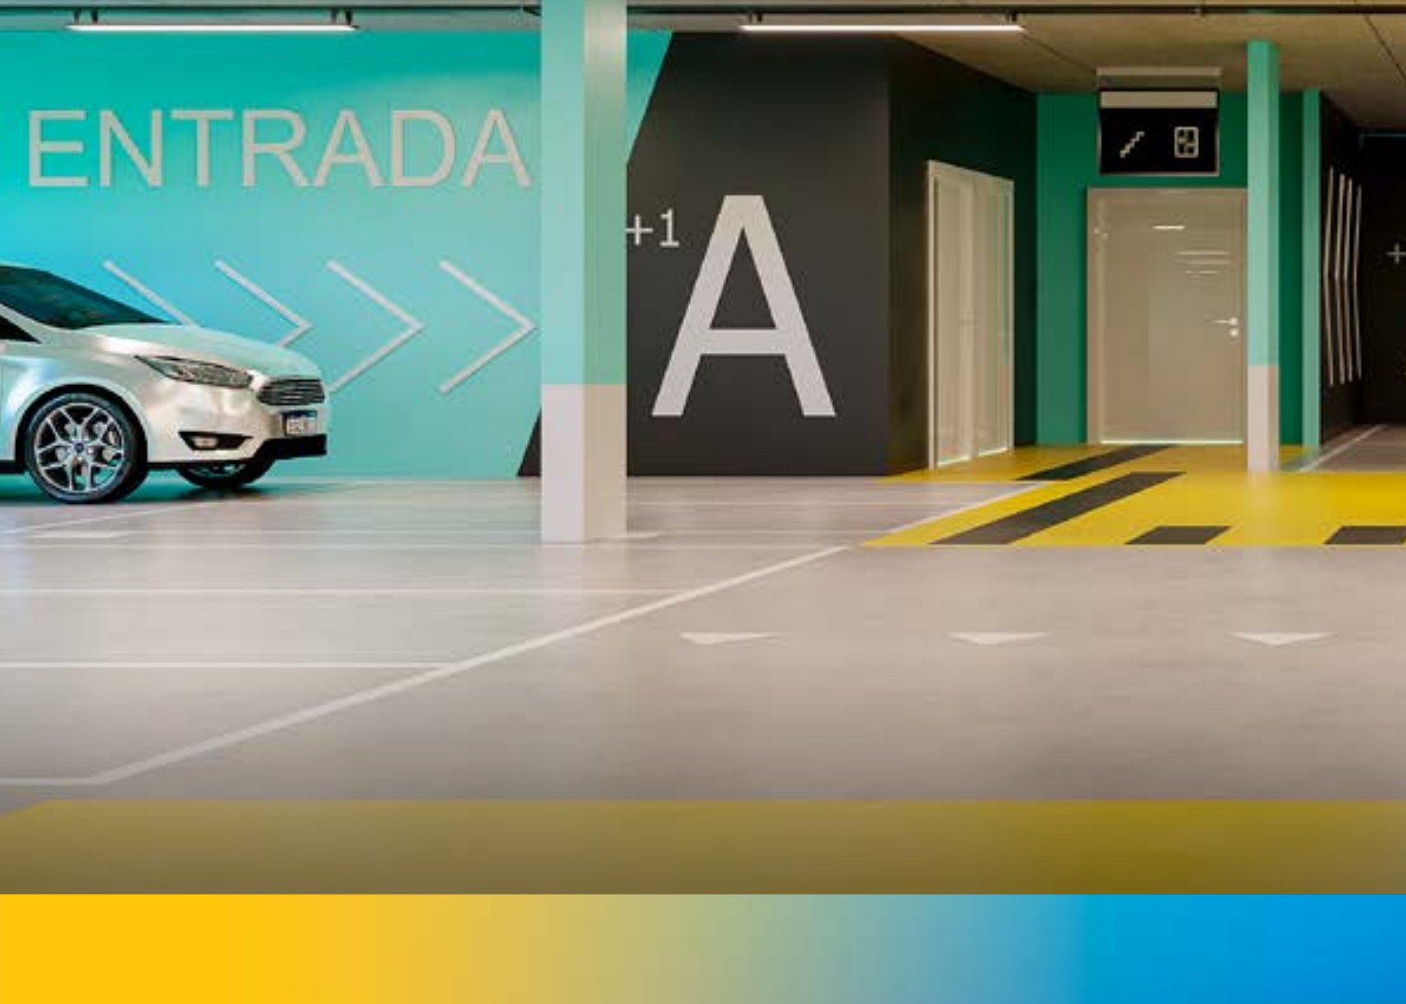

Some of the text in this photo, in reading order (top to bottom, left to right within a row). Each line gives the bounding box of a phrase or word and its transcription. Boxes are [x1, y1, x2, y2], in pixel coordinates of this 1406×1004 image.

[27, 109, 531, 187] ENTRADA
[626, 195, 836, 416] +1 A
